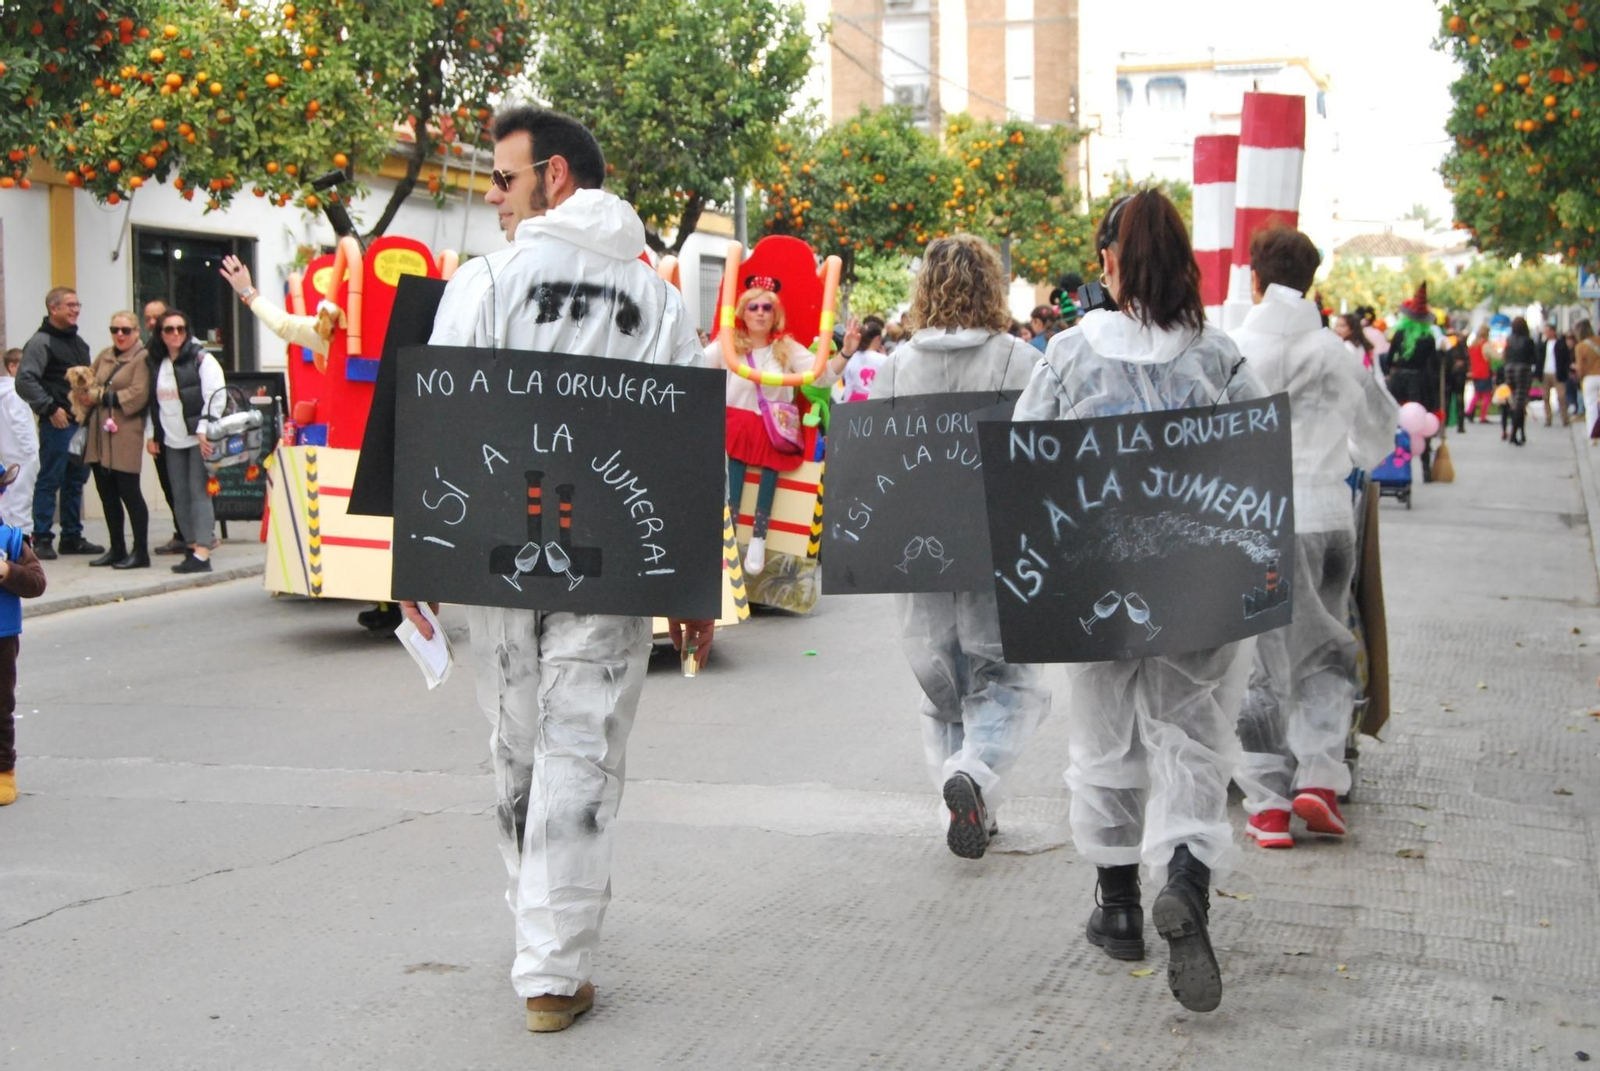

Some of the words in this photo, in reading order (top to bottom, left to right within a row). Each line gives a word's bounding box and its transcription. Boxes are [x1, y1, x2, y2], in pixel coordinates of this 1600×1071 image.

[417, 368, 454, 397] NO
[470, 370, 489, 393] A
[508, 369, 543, 394] LA
[556, 372, 686, 413] ORUJERA
[849, 416, 873, 438] NO
[885, 417, 897, 435] A
[906, 415, 928, 437] LA
[1009, 426, 1061, 463] NO
[1076, 427, 1101, 461] A
[1117, 421, 1153, 454] LA
[1164, 402, 1280, 448] ORUJERA
[877, 475, 895, 494] A
[903, 445, 933, 470] LA
[946, 440, 983, 470] JU
[482, 443, 509, 474] A
[533, 423, 574, 453] LA
[591, 450, 676, 577] JUMERA!
[1043, 495, 1077, 541] A
[1077, 469, 1123, 512] LA
[1142, 466, 1287, 538] JUMERA!
